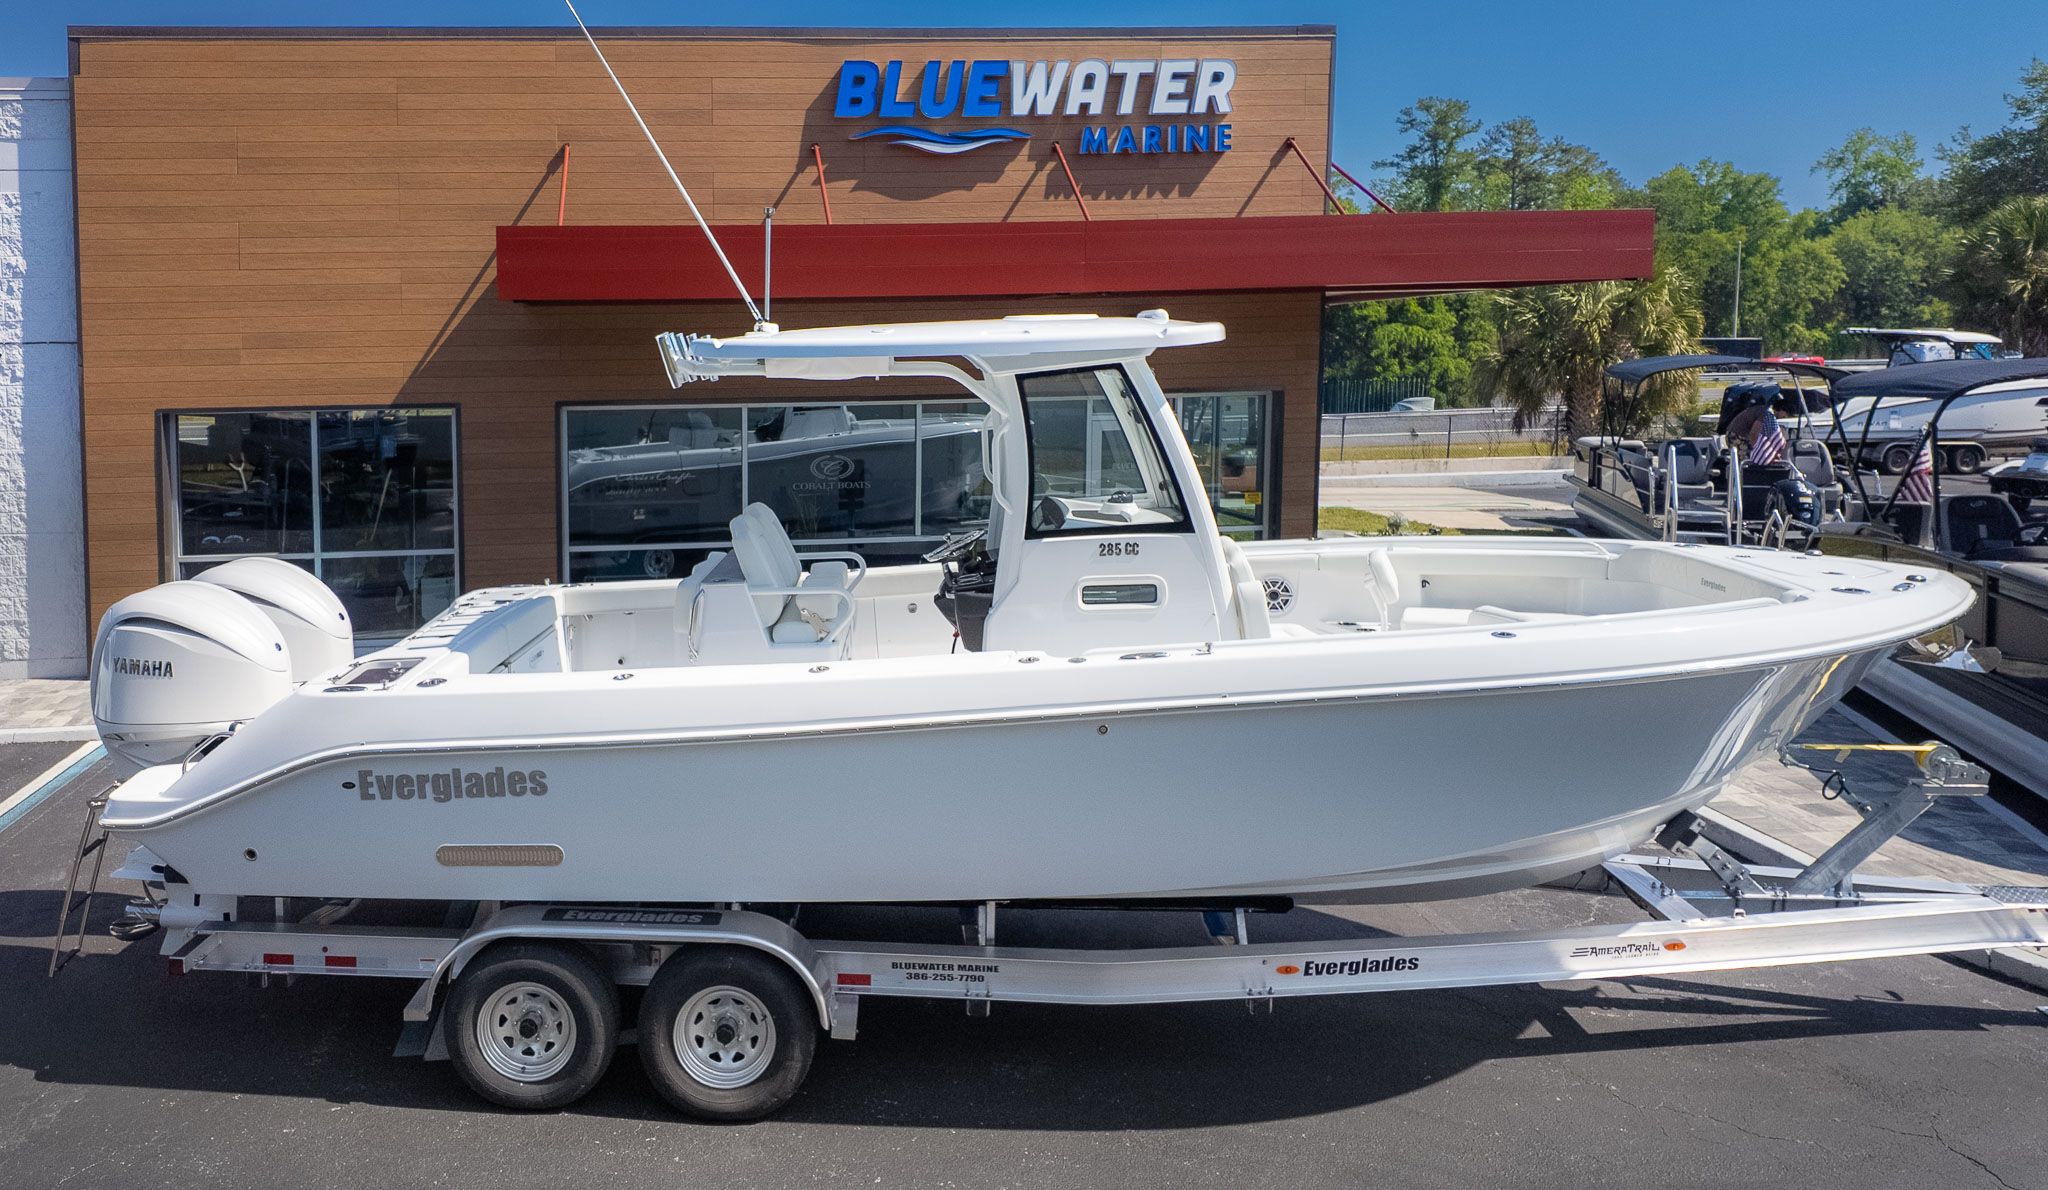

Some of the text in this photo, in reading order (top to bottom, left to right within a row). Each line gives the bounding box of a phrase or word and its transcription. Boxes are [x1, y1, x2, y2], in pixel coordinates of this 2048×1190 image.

[834, 58, 1238, 119] BLUEWATER
[1079, 124, 1233, 154] MARINE
[792, 480, 872, 491] COBALT BOATS
[1098, 543, 1140, 557] 285 CC
[113, 657, 174, 678] YAMAHA
[357, 766, 549, 803] Everglades
[562, 909, 704, 924] Everglades
[891, 961, 1000, 974] BLUEWATER MARINE
[1303, 956, 1420, 977] Everglades
[905, 972, 985, 983] 386-255-7790
